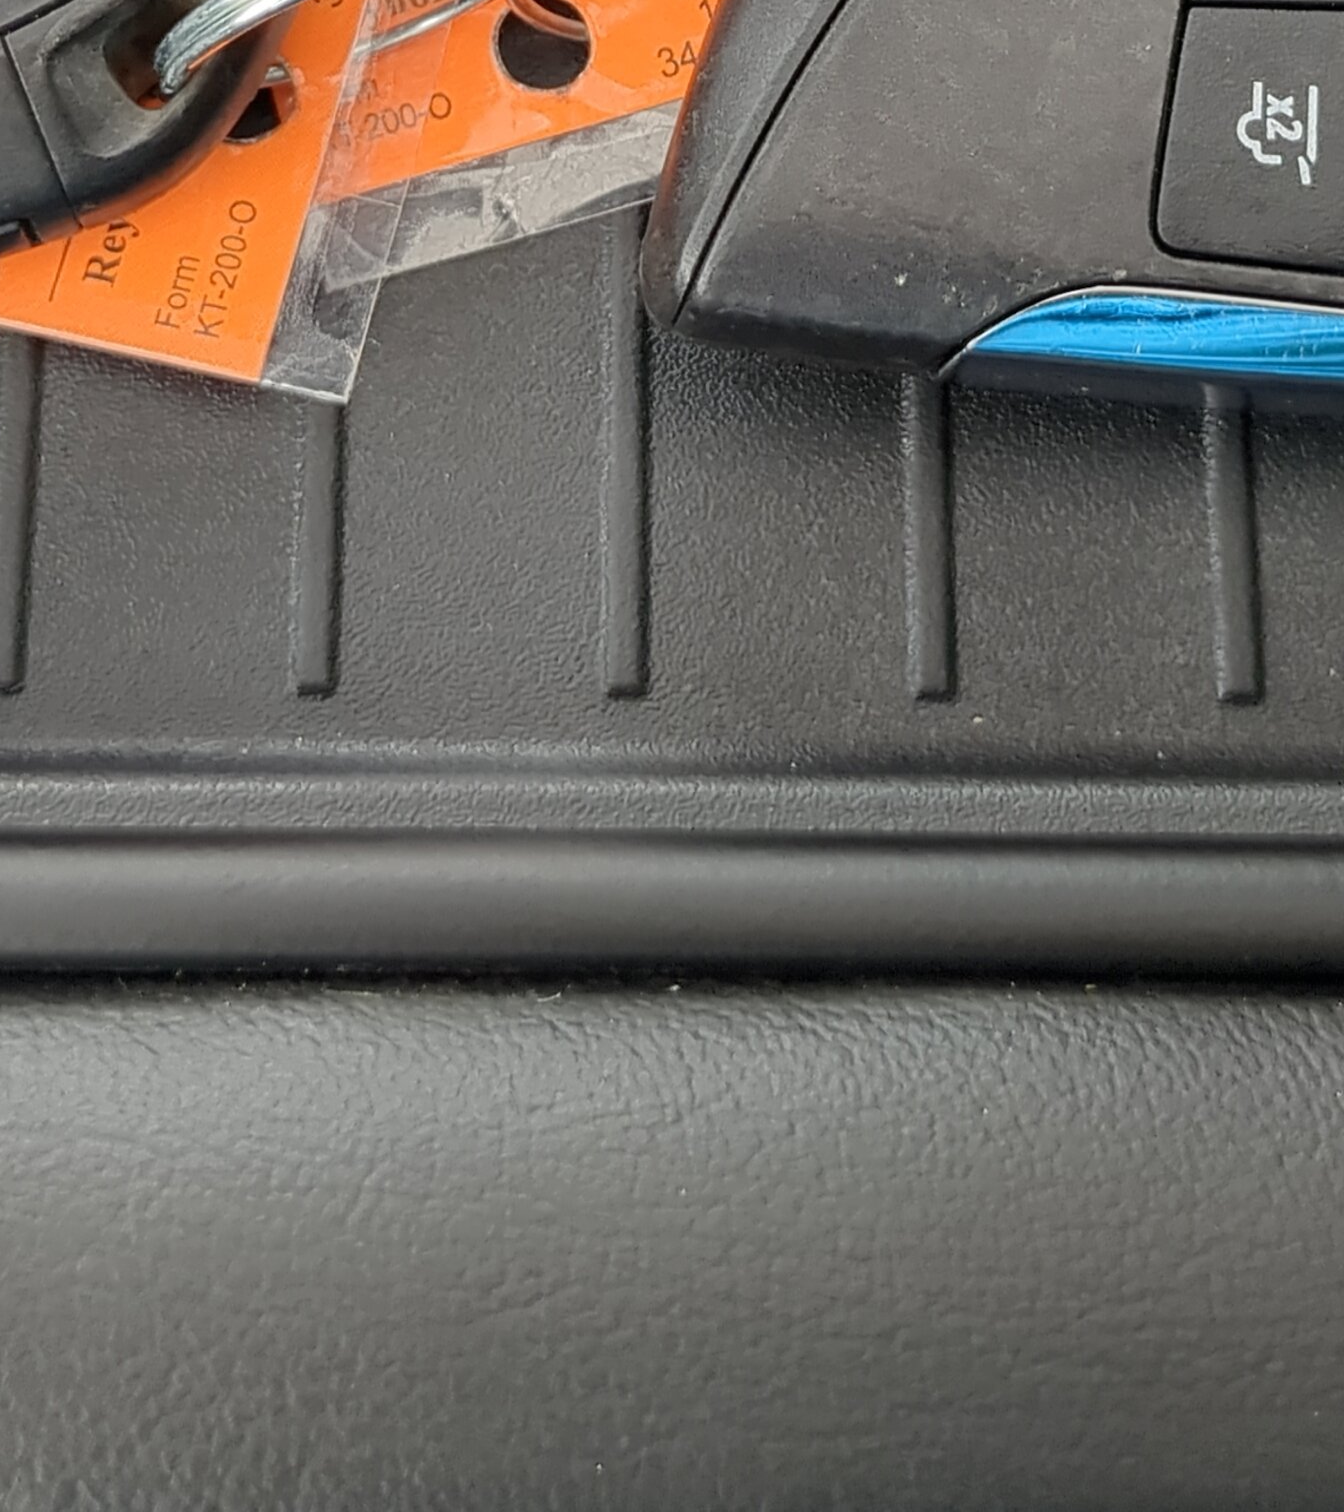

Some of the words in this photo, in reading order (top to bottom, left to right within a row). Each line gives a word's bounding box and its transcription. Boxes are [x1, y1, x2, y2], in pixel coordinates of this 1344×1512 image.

[1266, 94, 1303, 141] x2
[155, 255, 200, 329] Form
[193, 199, 257, 338] KT-200-O
